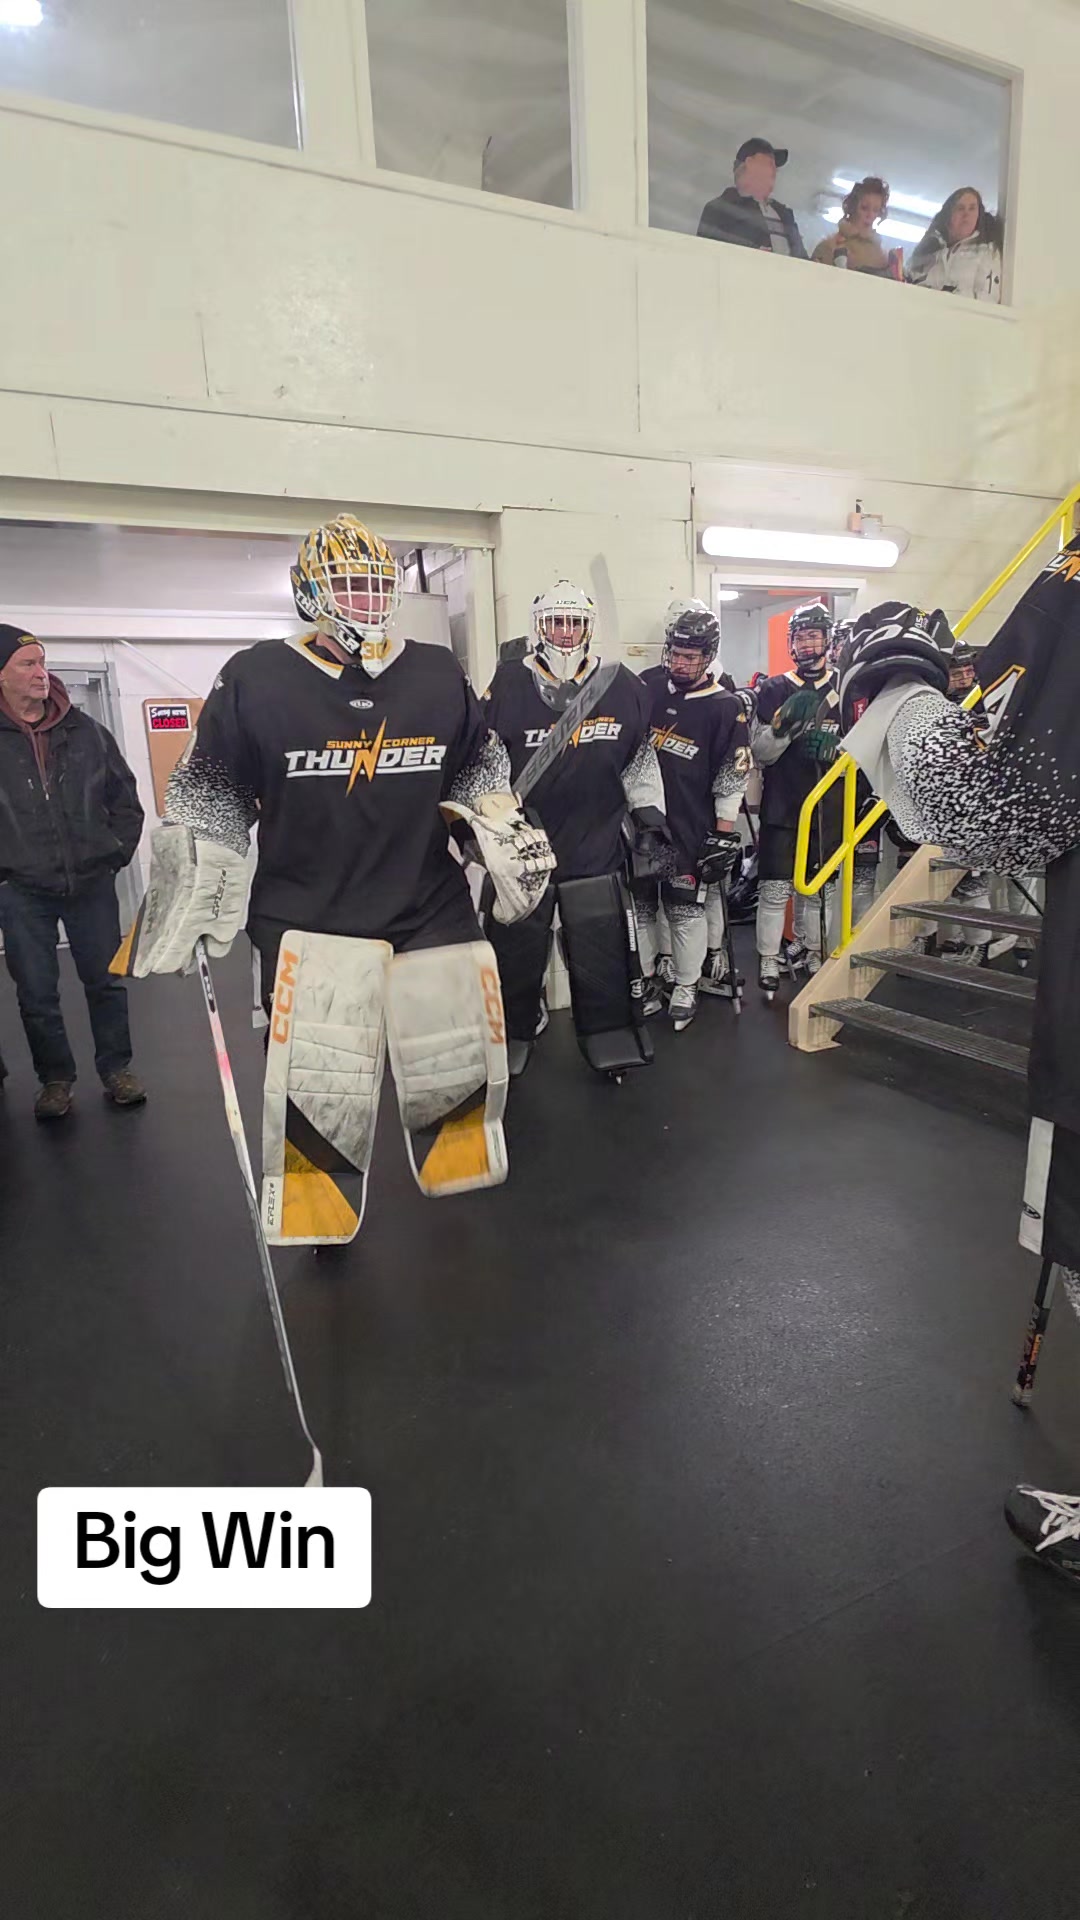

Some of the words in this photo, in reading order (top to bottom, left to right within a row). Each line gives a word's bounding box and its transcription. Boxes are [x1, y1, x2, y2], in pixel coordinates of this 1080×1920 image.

[153, 717, 187, 728] CLOSED
[524, 722, 622, 748] THDER
[325, 739, 373, 749] SUNNY
[382, 736, 436, 748] CORNER
[284, 742, 447, 784] THUNDER
[272, 948, 299, 1045] CCM
[480, 966, 504, 1044] CCM
